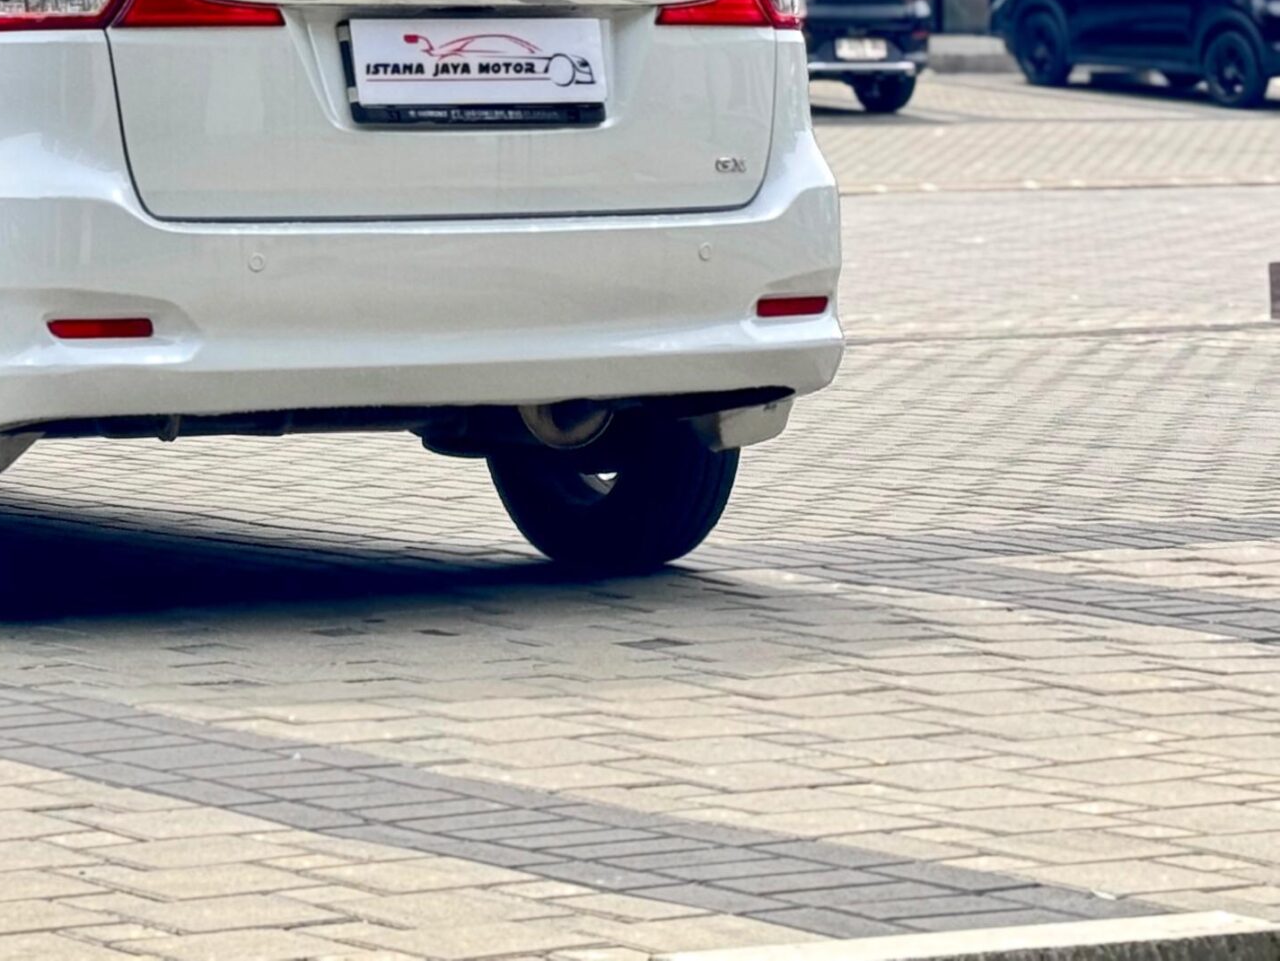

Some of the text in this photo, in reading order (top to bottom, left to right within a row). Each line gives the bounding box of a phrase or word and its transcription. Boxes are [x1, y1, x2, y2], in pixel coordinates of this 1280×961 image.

[365, 61, 536, 77] ISTANA JAYA MOTOR
